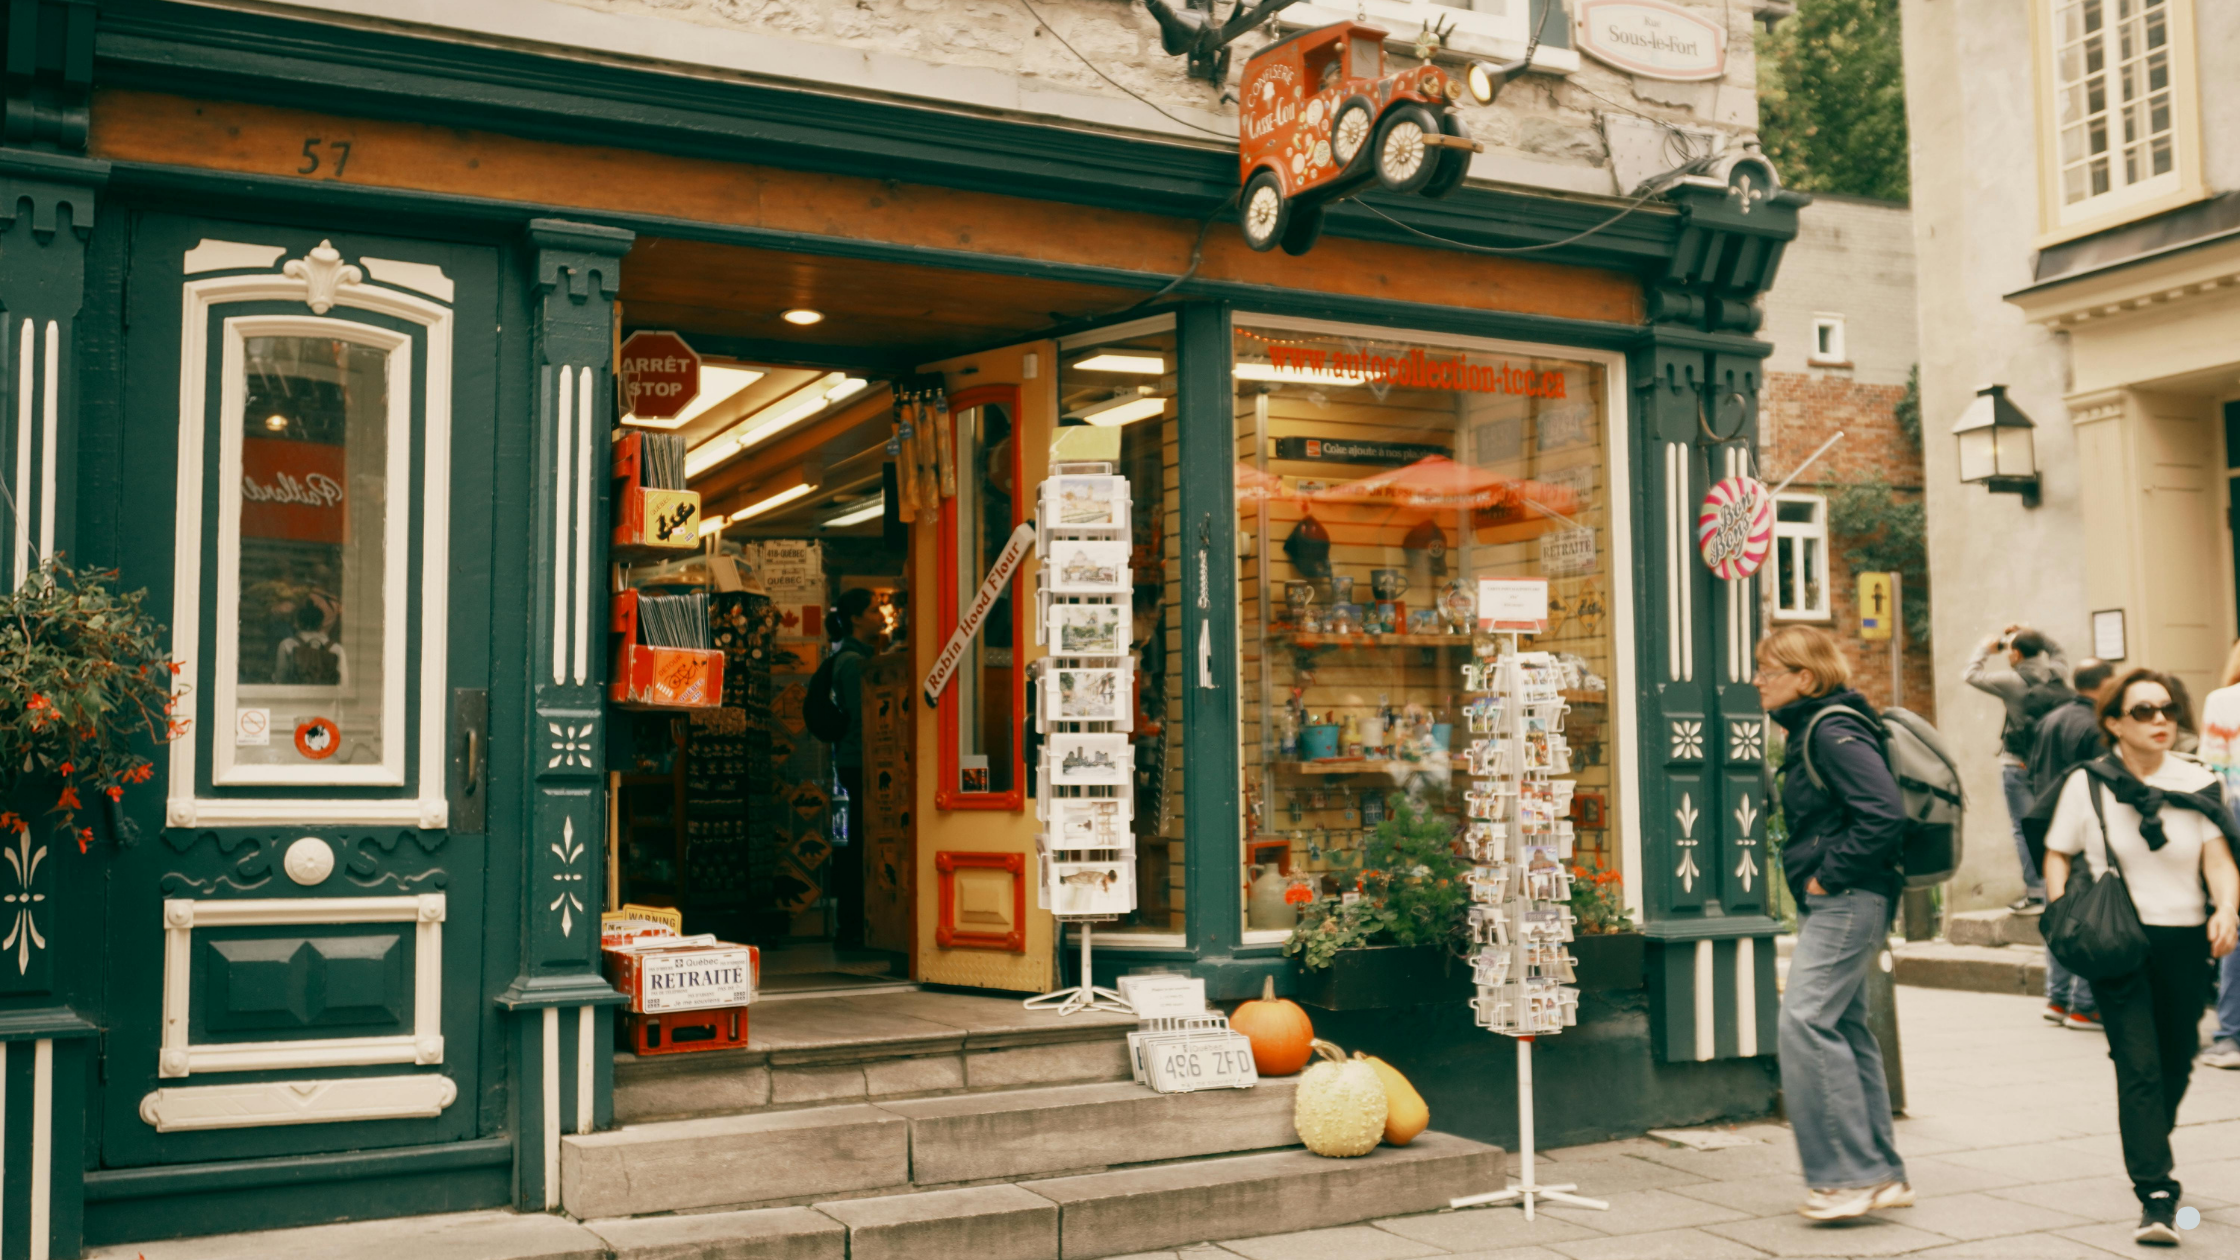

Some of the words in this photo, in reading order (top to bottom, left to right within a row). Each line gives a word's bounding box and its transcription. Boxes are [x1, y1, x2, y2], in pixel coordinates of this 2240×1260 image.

[1644, 15, 1662, 28] Rue
[1608, 25, 1699, 56] Sous-le-Fort
[297, 138, 352, 178] 57
[621, 355, 691, 373] ARRÊT
[1268, 346, 1567, 399] www.autocollection-tcc.ca
[629, 381, 683, 397] STOP
[1323, 442, 1347, 455] Coke
[1348, 445, 1377, 457] ajoute
[1718, 491, 1752, 534] Bon
[1710, 513, 1751, 565] Bons
[927, 641, 962, 691] Robin
[959, 594, 991, 638] Hood
[987, 541, 1020, 591] Flour
[628, 912, 676, 928] WARNING
[685, 957, 719, 968] Québec
[1165, 1052, 1202, 1079] 496
[1212, 1049, 1251, 1074] ZFD
